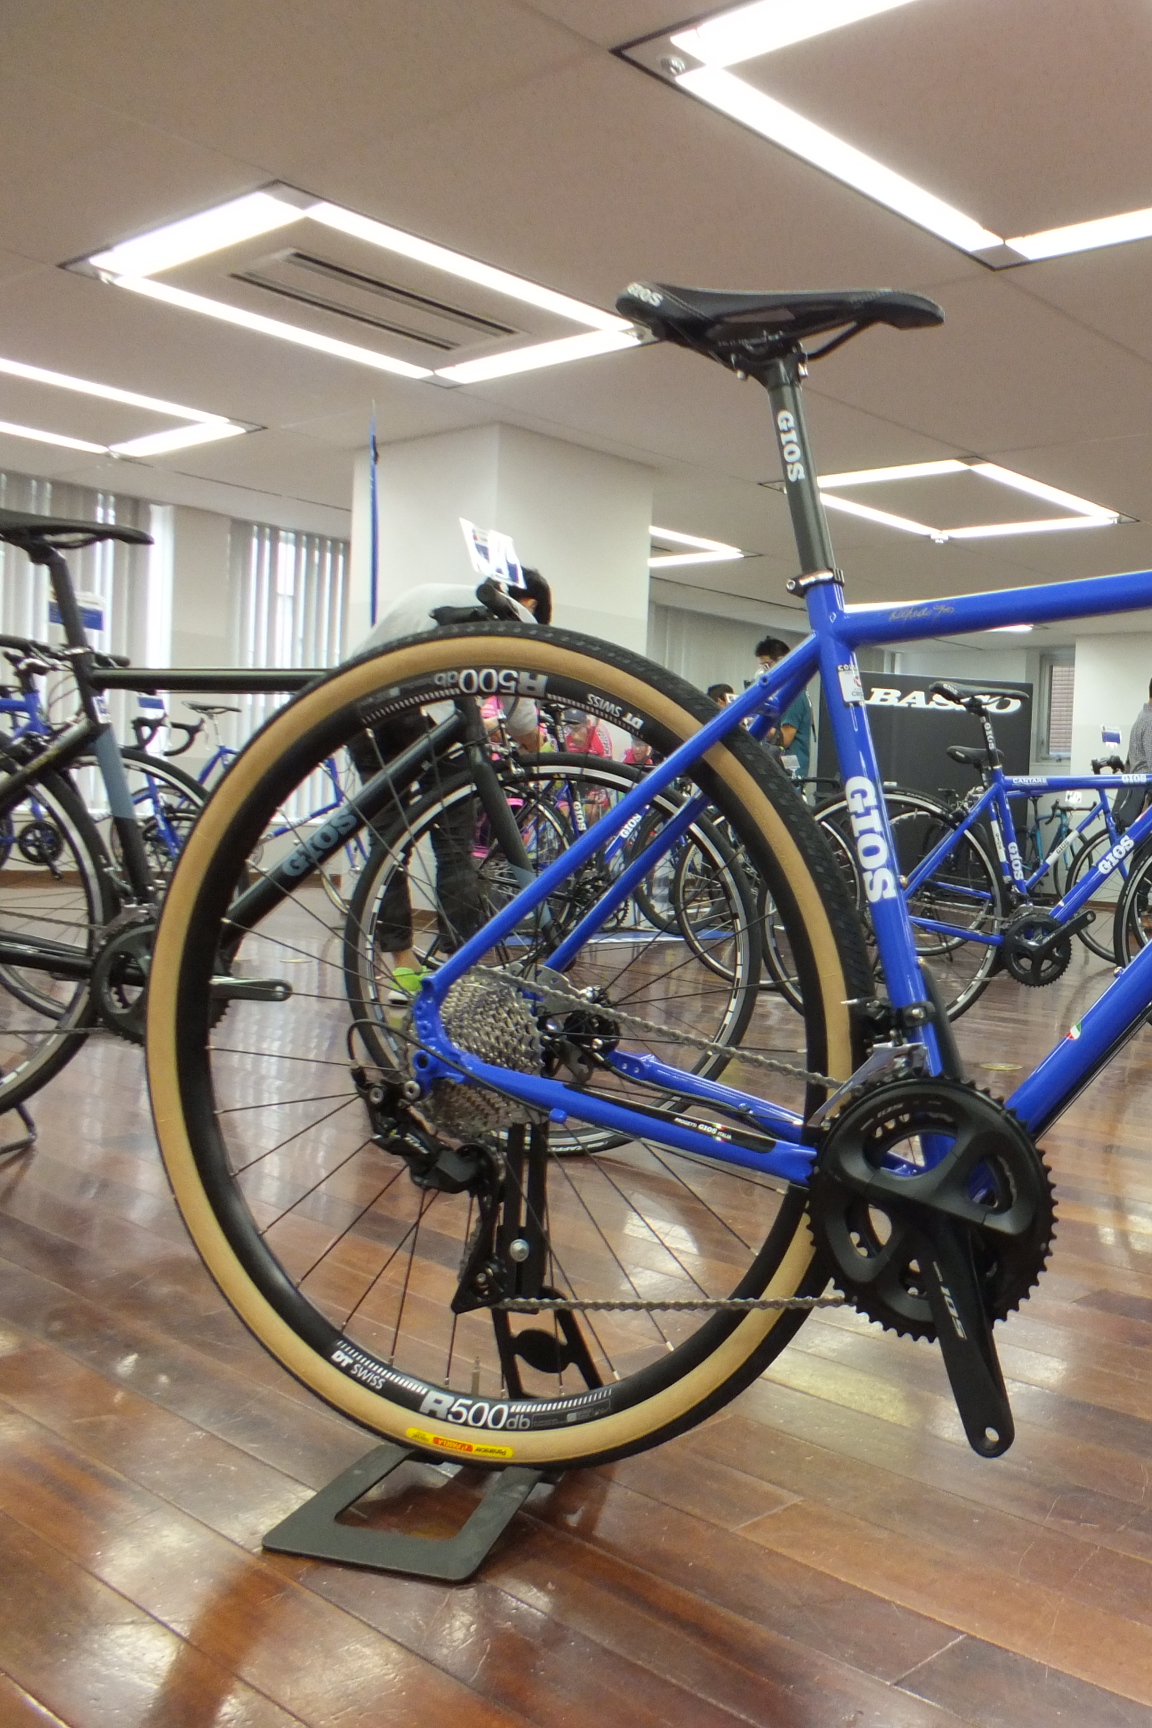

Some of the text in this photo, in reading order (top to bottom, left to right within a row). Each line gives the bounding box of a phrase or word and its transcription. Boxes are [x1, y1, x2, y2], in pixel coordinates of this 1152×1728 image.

[777, 409, 805, 482] GIOS
[586, 692, 644, 730] DT SWISS
[864, 687, 1021, 714] BASO
[984, 722, 995, 750] GIOS
[1121, 774, 1147, 783] GIOS
[573, 801, 587, 831] GIOS
[620, 813, 642, 838] GIOS
[282, 807, 357, 877] GIOS
[845, 776, 897, 903] GIOS
[1056, 840, 1070, 855] GIOS
[1098, 835, 1135, 874] GIOS
[1008, 842, 1024, 881] GIOS
[331, 1350, 386, 1389] DT SWISS
